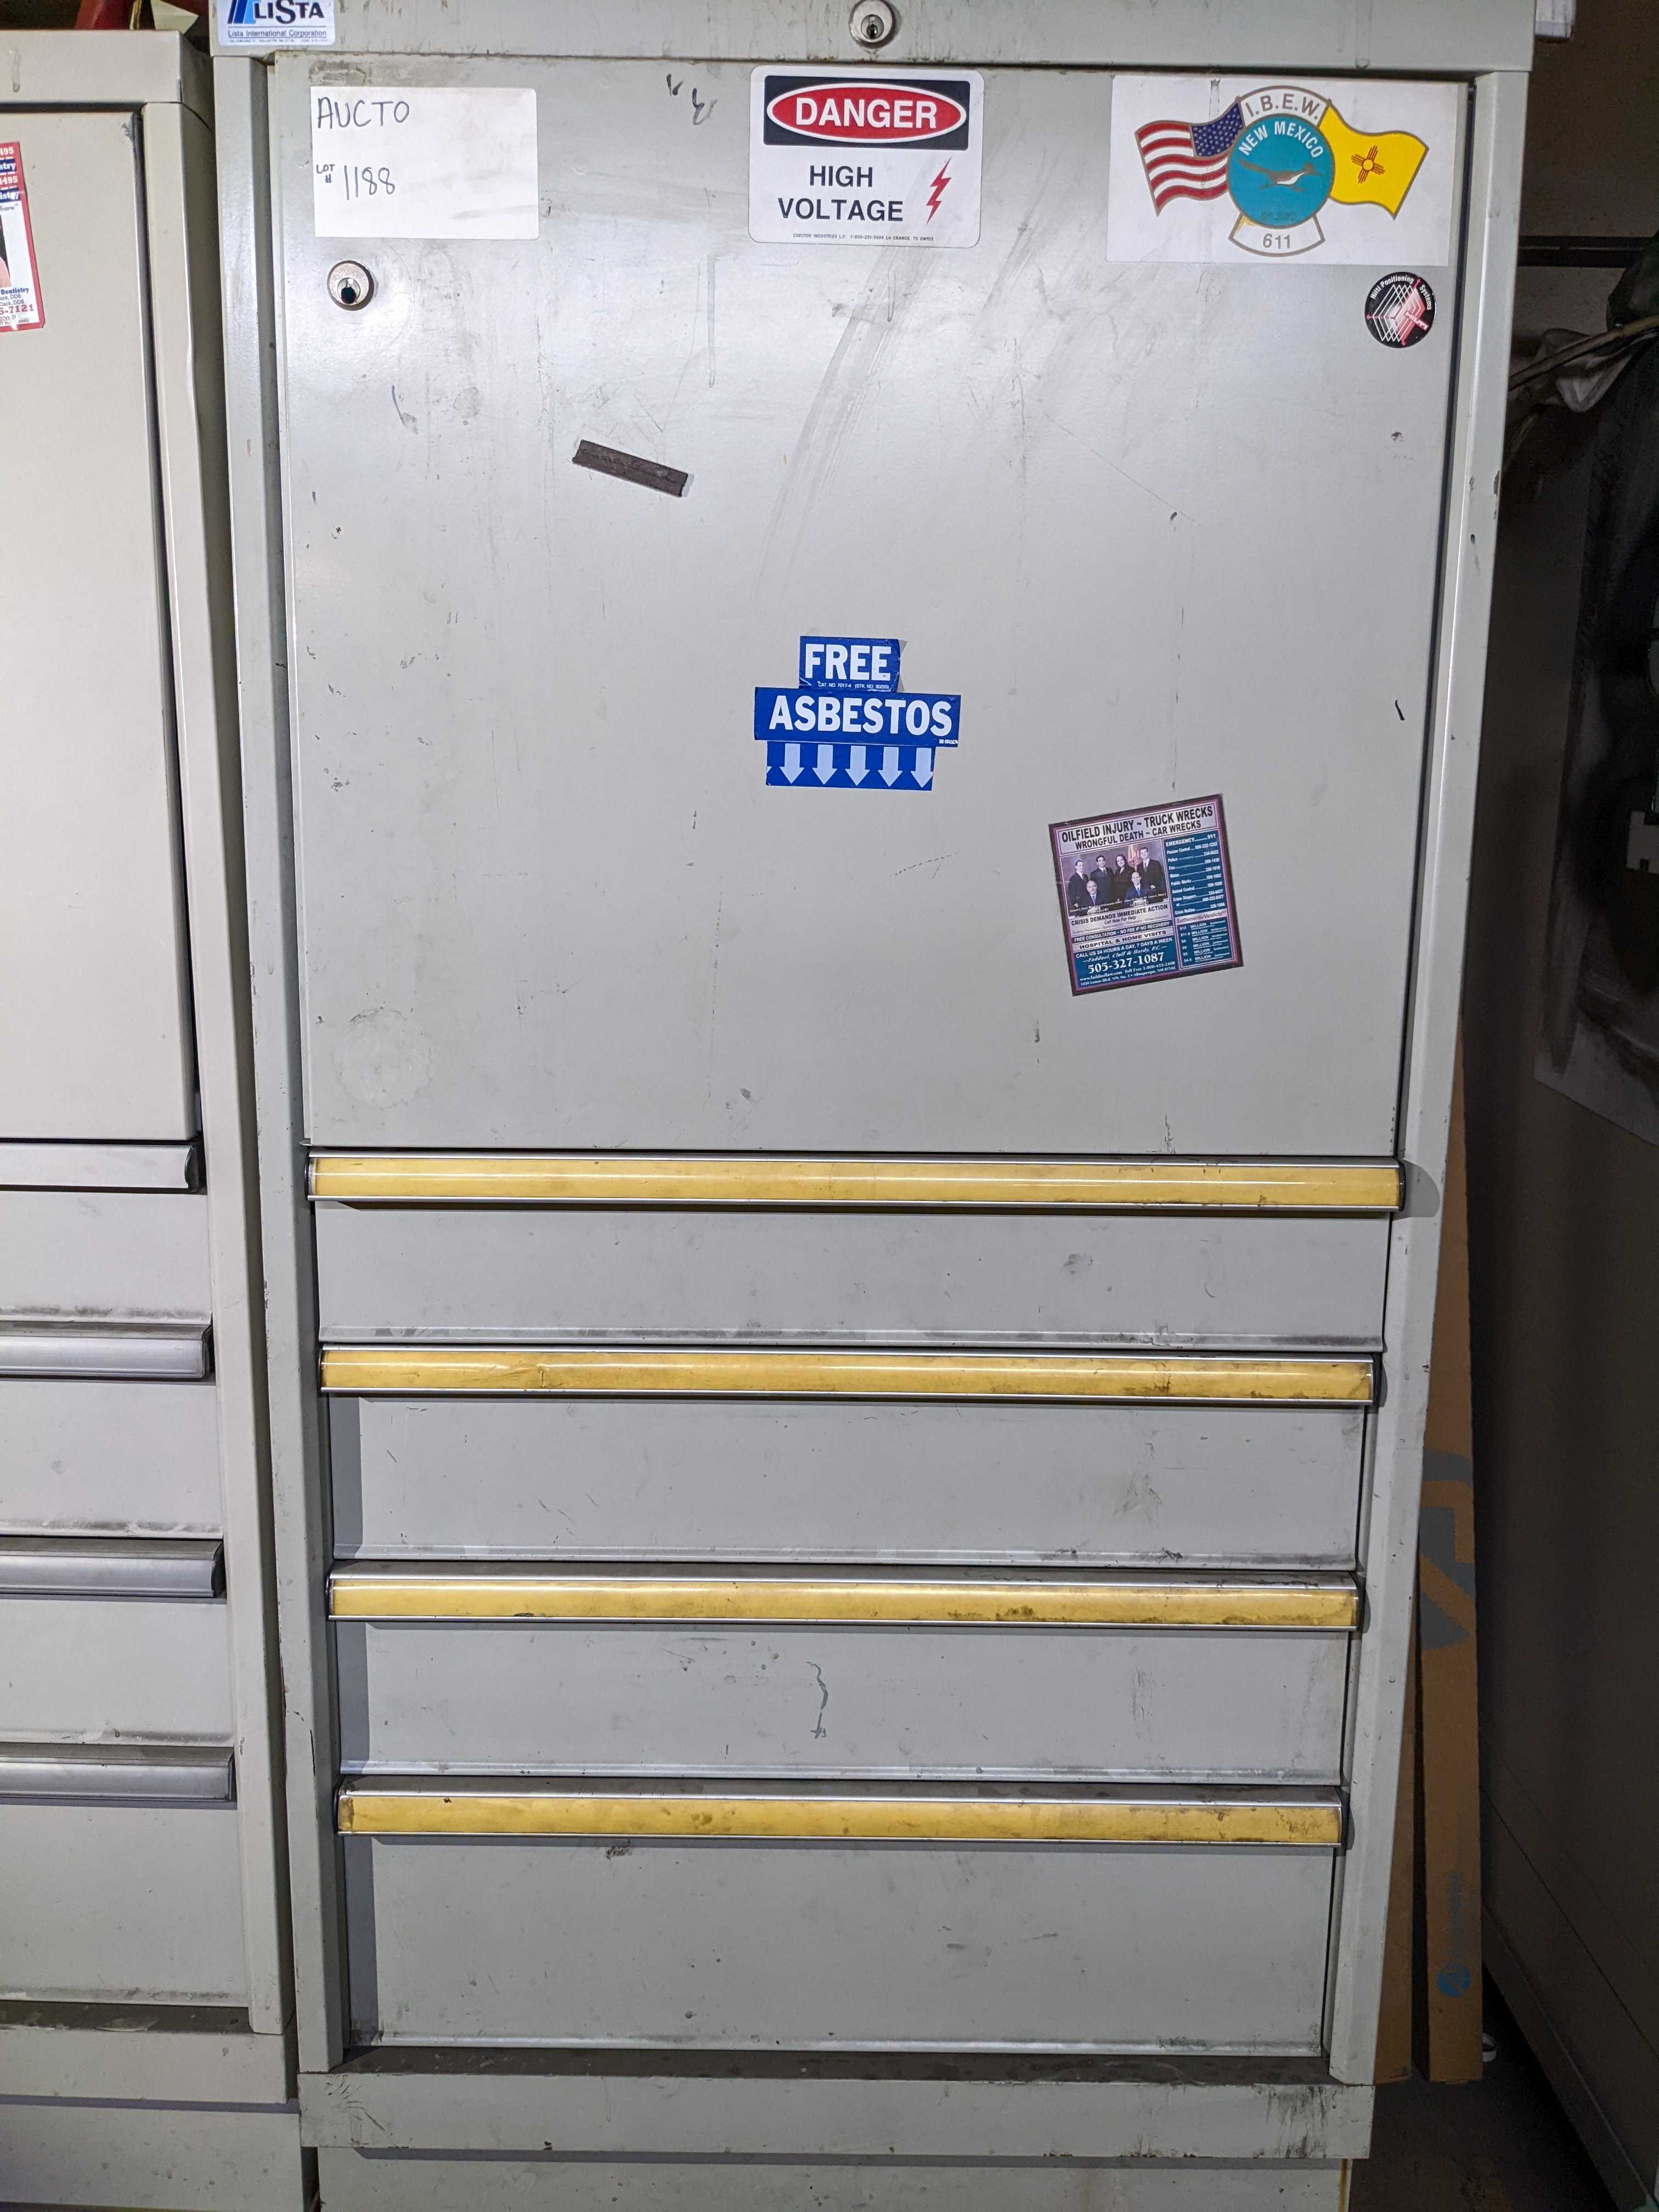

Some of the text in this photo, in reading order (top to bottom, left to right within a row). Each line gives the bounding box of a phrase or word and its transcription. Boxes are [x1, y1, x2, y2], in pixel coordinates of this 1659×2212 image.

[254, 0, 325, 24] LISTA
[318, 97, 410, 129] AUCTO
[795, 98, 937, 129] DANGER
[1245, 93, 1320, 120] I.B.E.W.
[1238, 121, 1324, 158] NEW MEXICO
[316, 164, 335, 174] LOT
[809, 165, 873, 188] HIGH
[344, 165, 395, 200] 1188
[777, 198, 904, 222] VOLTAGE
[1262, 233, 1291, 249] 611
[1380, 275, 1414, 288] Positioning
[1419, 284, 1432, 311] Systems
[805, 644, 891, 681] FREE
[769, 695, 952, 737] ASBESTOS
[1061, 826, 1100, 843] OILFIELD
[1102, 820, 1134, 835] INJURY
[1143, 812, 1174, 828] TRUCK
[1177, 805, 1212, 822] WRECKS
[1075, 835, 1118, 850] WRONGFUL
[1119, 830, 1144, 842] DEATH
[1152, 826, 1167, 836] CAR
[1170, 820, 1201, 833] WRECKS
[1165, 837, 1194, 847] EMERGENCY
[1090, 913, 1115, 922] DEMANDS
[1116, 907, 1146, 917] IMMEDIATE
[1085, 930, 1116, 940] CONSULTATION
[1147, 921, 1170, 929] RECOVERY
[1079, 939, 1113, 949] HOSPITAL
[1087, 951, 1165, 974] 505-327-1087
